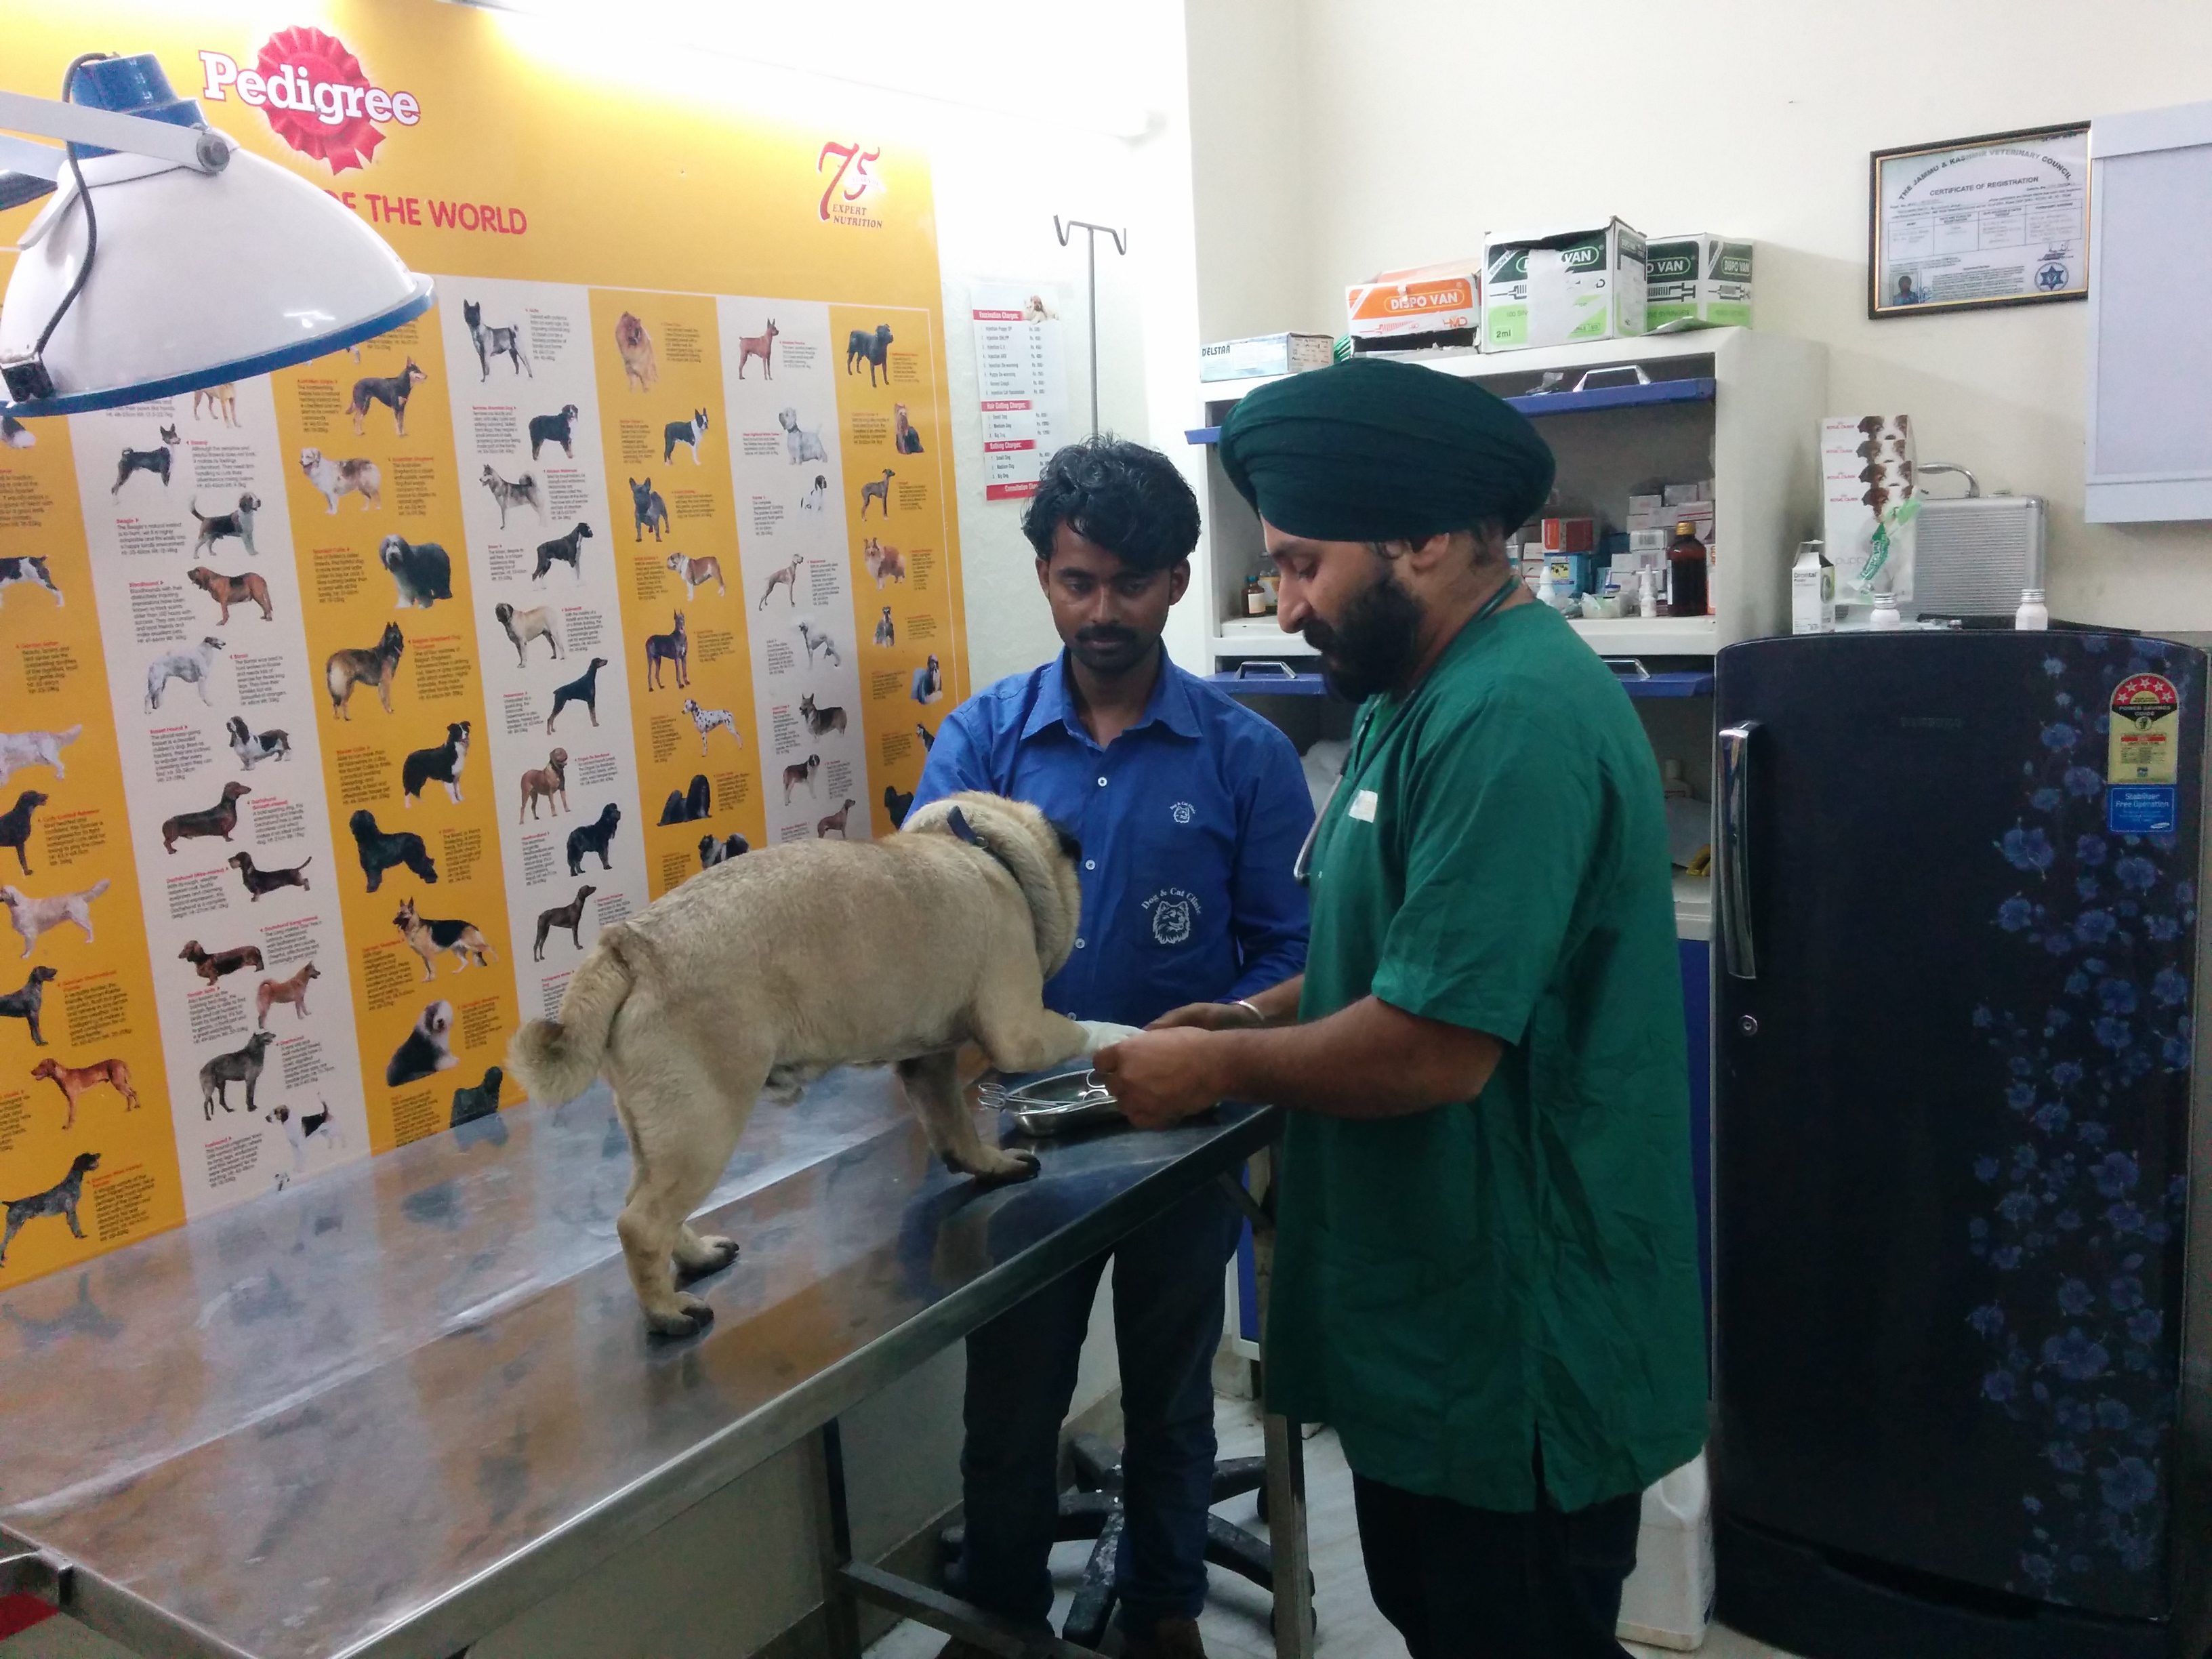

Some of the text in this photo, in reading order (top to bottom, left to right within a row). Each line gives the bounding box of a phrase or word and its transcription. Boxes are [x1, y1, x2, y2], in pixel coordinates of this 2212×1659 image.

[199, 49, 421, 127] Pedigree
[818, 142, 880, 221] 75
[1898, 148, 2072, 201] THE JAMMU & KASHMIR VETERINARY COUNCIL
[1929, 184, 1974, 197] CERTIFICATE
[1976, 182, 1986, 190] OF
[1987, 176, 2039, 189] REGISTRATION
[363, 192, 422, 227] THE
[428, 199, 528, 235] WORLD
[832, 203, 867, 216] EXPERT
[833, 215, 883, 229] NUTRITION
[1657, 260, 1684, 272] VAN
[1391, 291, 1458, 311] DISPO VAN
[1496, 329, 1512, 340] 2ml
[1202, 344, 1231, 358] DELSTAR
[1141, 886, 1202, 916] Dog & Cat Clinic
